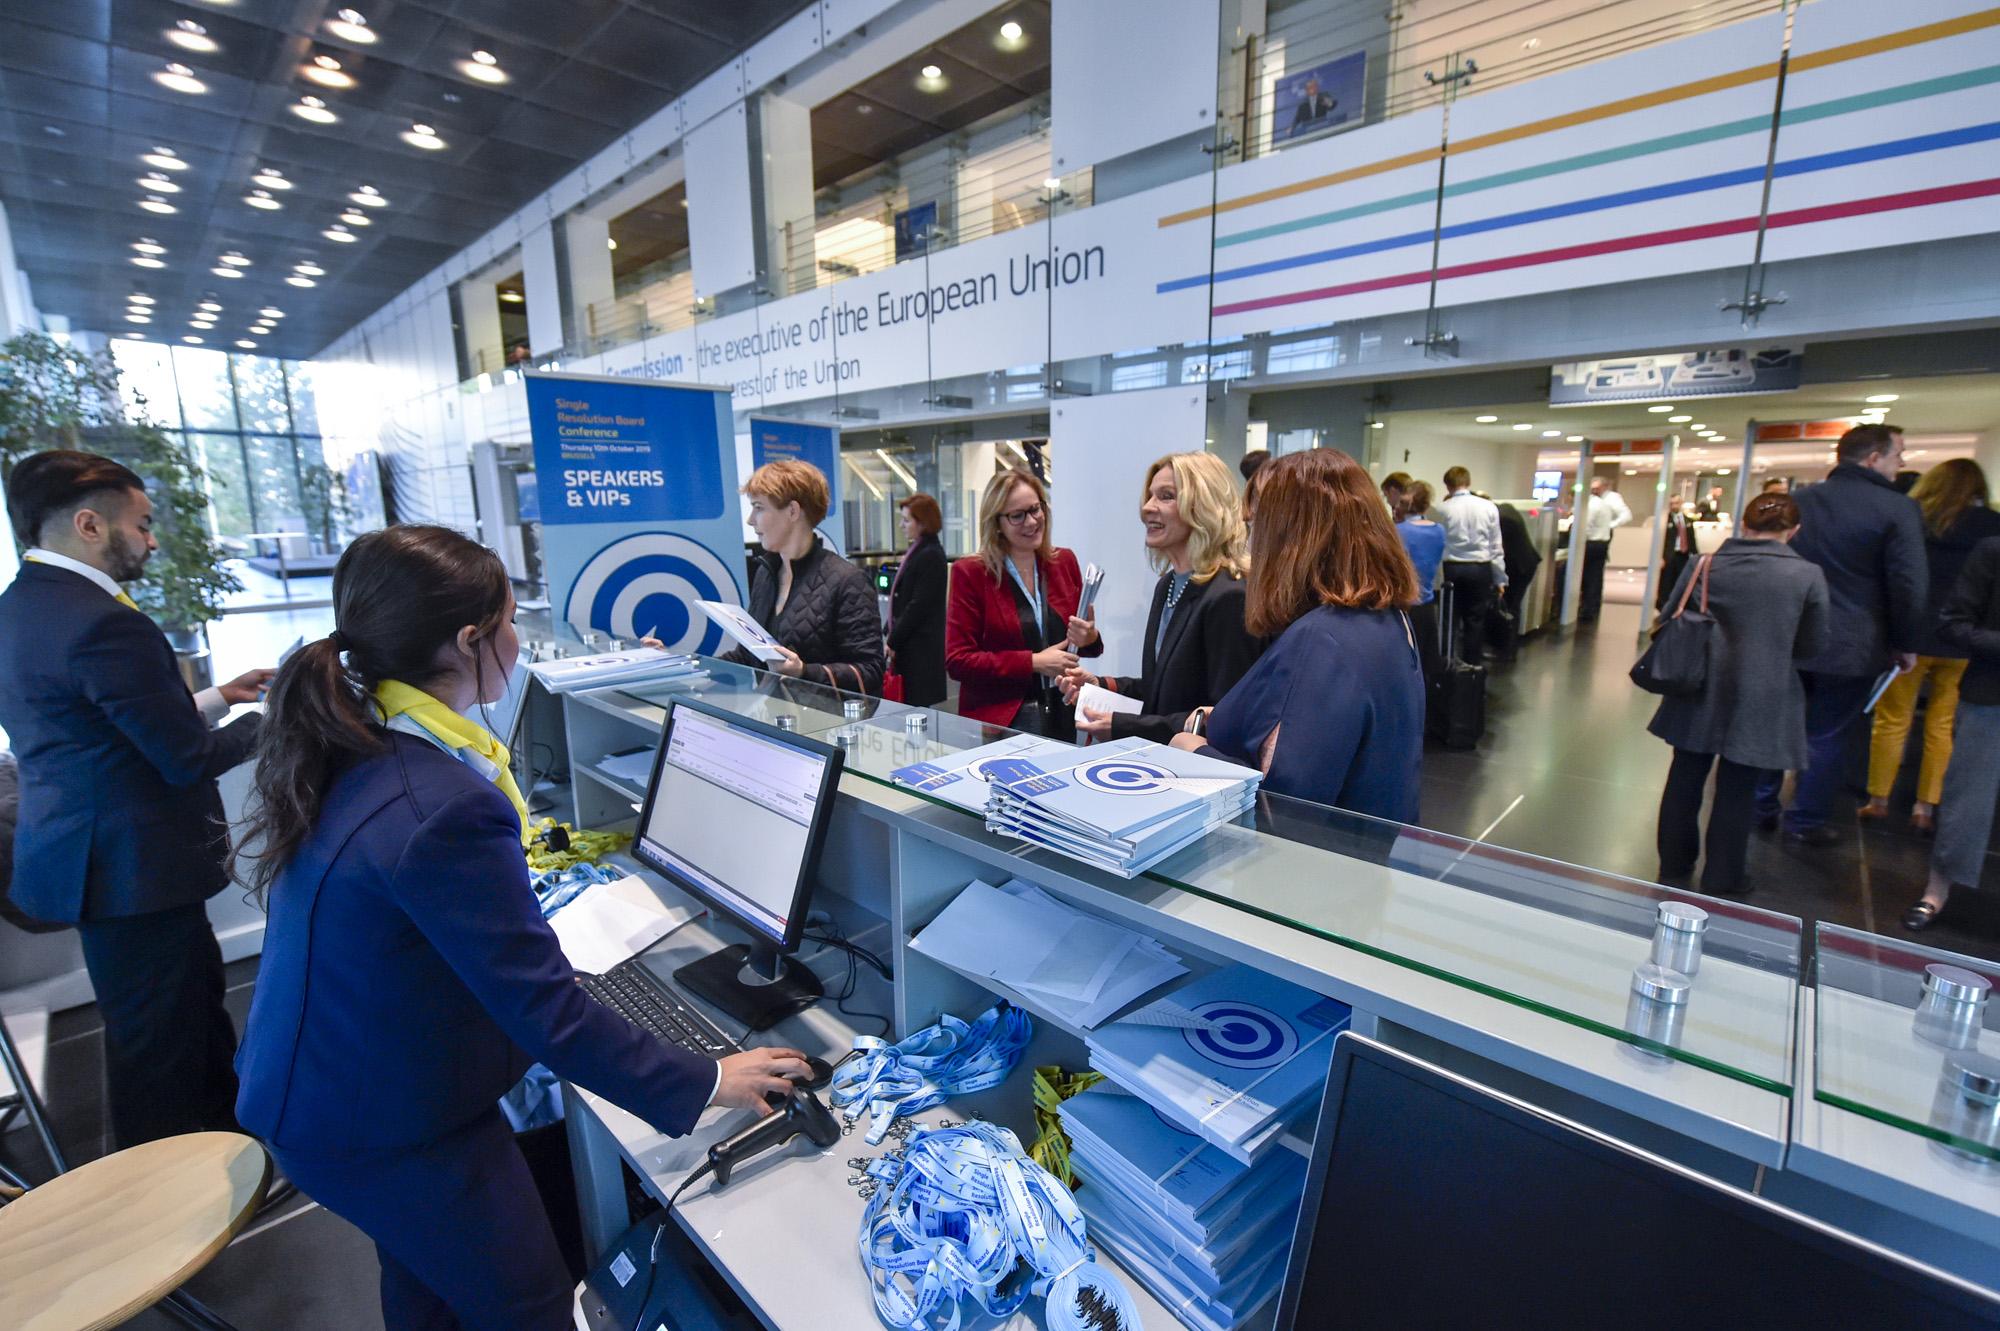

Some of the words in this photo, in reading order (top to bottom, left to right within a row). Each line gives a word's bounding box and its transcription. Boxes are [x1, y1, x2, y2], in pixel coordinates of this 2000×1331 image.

[698, 339, 721, 368] the
[725, 321, 802, 362] executive
[808, 306, 829, 342] of
[836, 301, 869, 336] the
[877, 272, 997, 324] European
[1009, 245, 1104, 296] Union
[764, 367, 779, 393] of
[784, 364, 807, 390] the
[814, 357, 861, 385] Union
[555, 398, 589, 411] Single
[557, 411, 613, 424] Resolution
[615, 415, 645, 426] Board
[559, 425, 619, 437] Conference
[564, 470, 665, 488] SPEAKERS
[566, 490, 583, 507] &
[587, 490, 631, 506] VIPs
